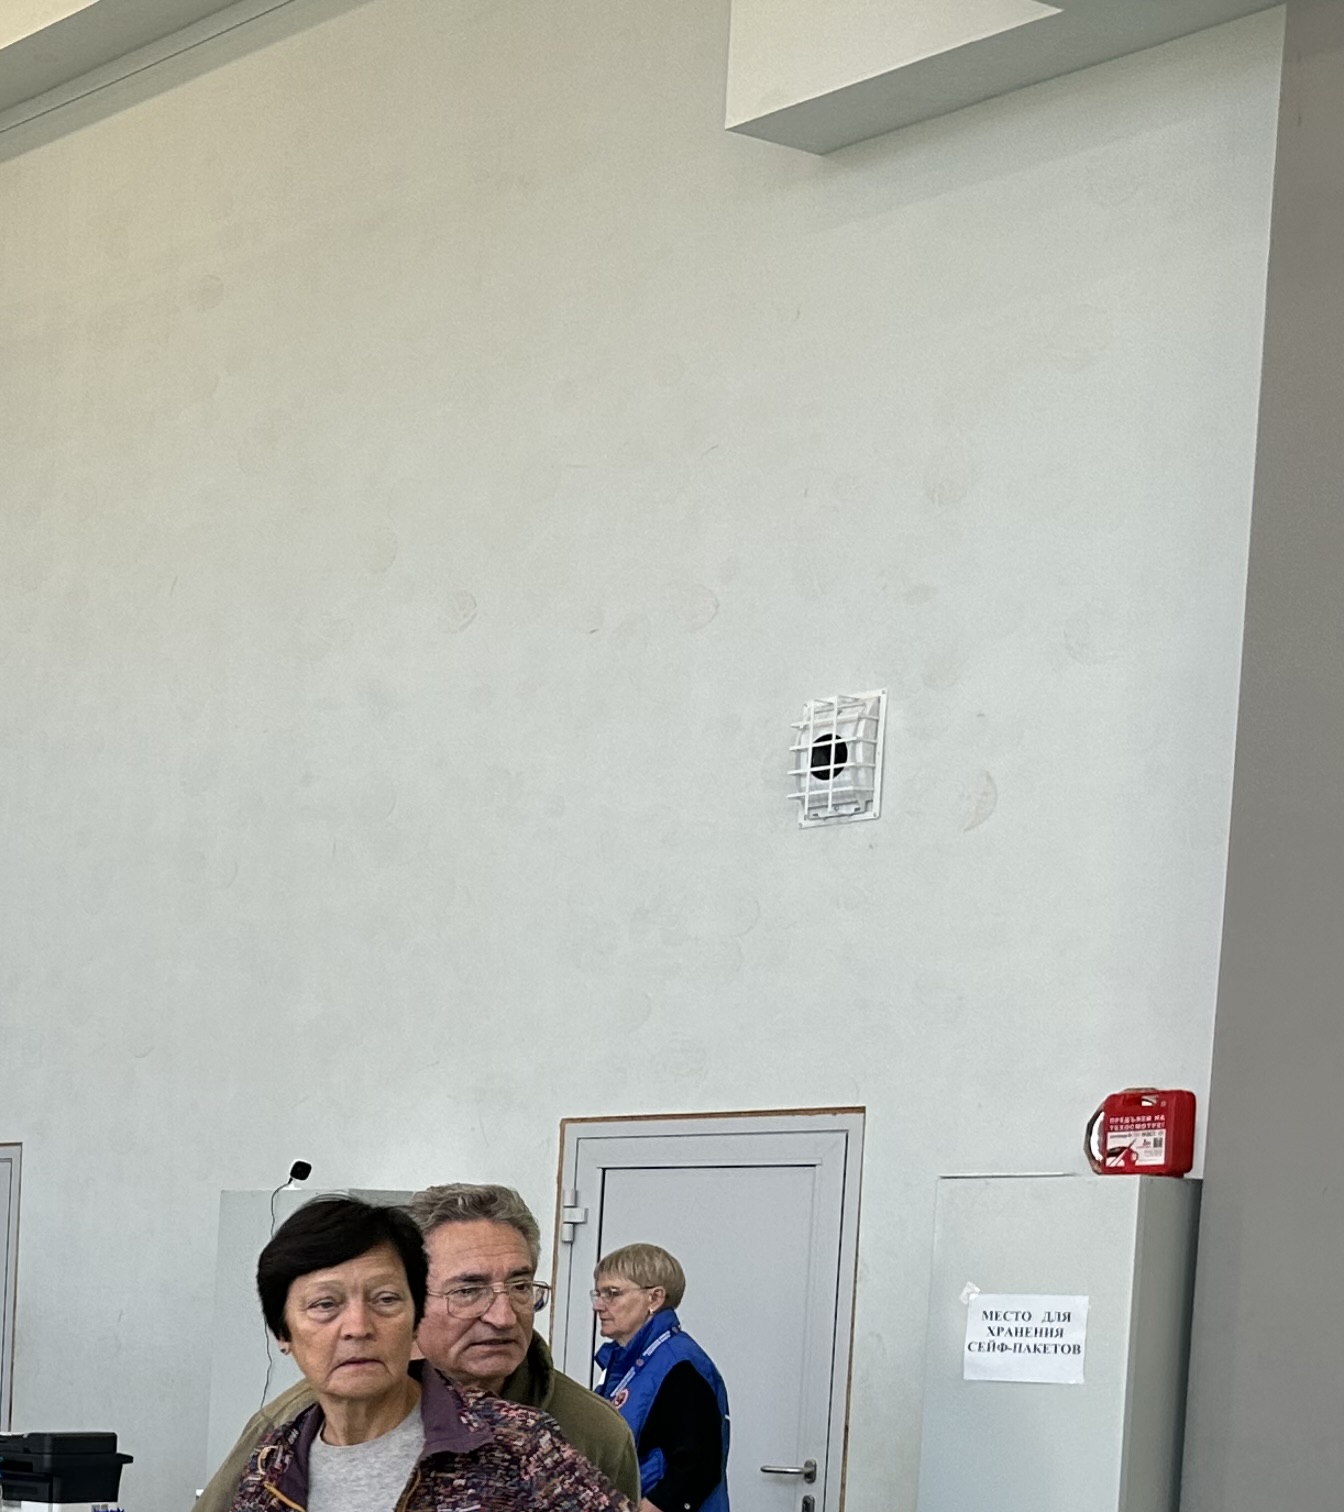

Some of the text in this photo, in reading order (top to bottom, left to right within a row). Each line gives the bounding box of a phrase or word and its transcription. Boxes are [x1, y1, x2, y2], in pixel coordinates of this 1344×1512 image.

[981, 1309, 1072, 1323] МЕСТО ДЛЯ
[986, 1325, 1064, 1338] ХРАНЕНИЯ
[967, 1339, 1081, 1355] СЕЙФ-ПАКЕТОВ
